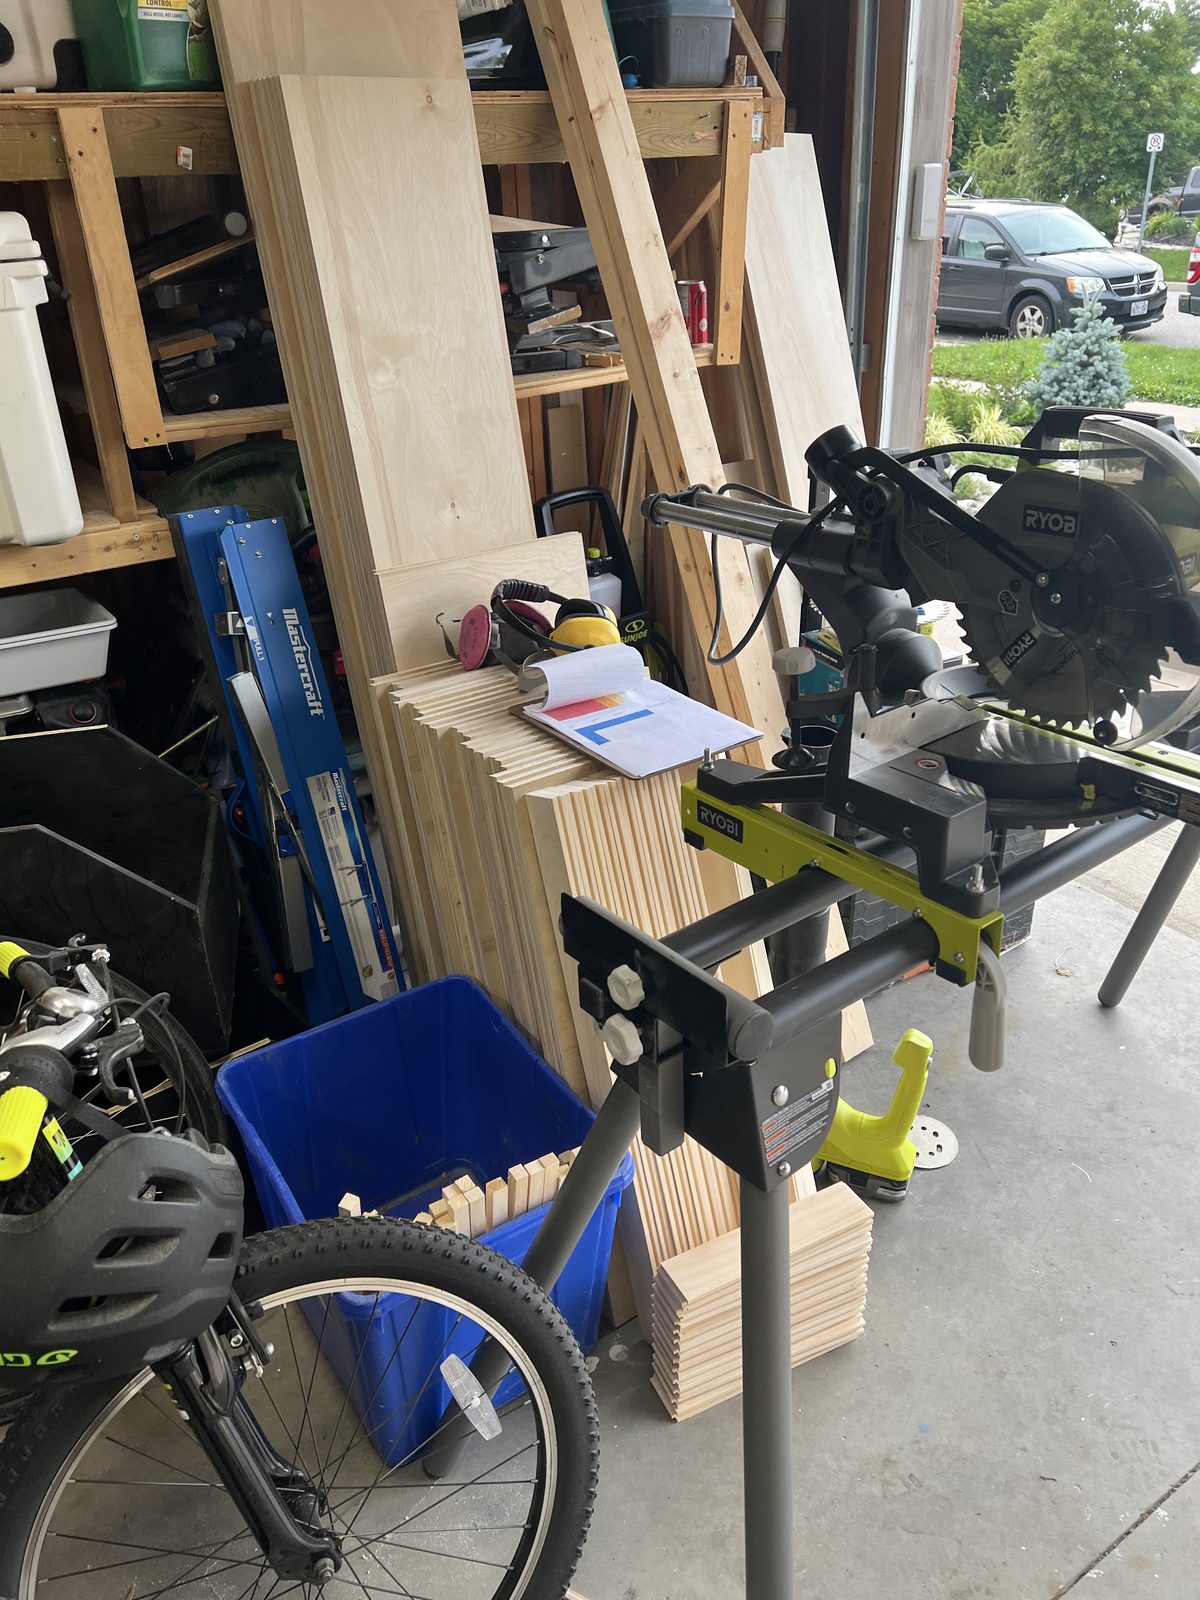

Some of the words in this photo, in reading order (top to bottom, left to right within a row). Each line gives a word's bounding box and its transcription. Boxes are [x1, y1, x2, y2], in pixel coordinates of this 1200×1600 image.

[1026, 509, 1076, 534] RYOB
[282, 607, 324, 717] Mastercraft
[700, 805, 738, 837] RYOBI
